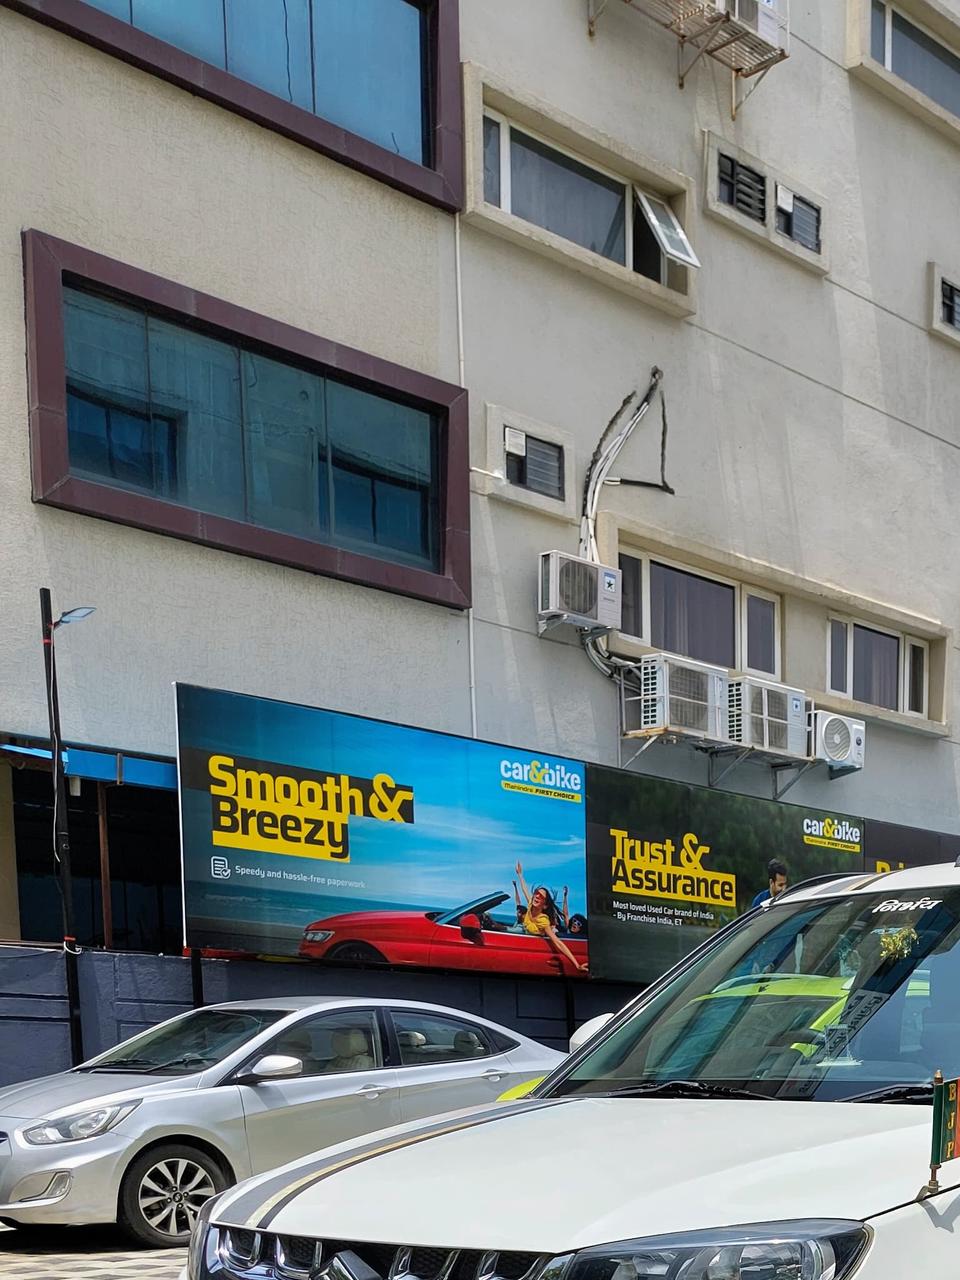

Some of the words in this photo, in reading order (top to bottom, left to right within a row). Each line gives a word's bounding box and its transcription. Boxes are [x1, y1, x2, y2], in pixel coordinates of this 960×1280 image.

[208, 755, 364, 817] Smooth
[369, 773, 414, 823] &
[500, 760, 581, 791] car&bike
[535, 788, 553, 796] FIRST
[553, 791, 576, 800] CHOICE
[212, 795, 349, 859] Breezy
[803, 817, 860, 842] car&bike
[610, 828, 675, 866] Trust
[680, 832, 710, 871] &
[235, 865, 265, 878] Speedy
[267, 868, 282, 879] and
[283, 871, 326, 884] hassle-free
[327, 876, 366, 889] paperwork
[612, 858, 733, 901] Assurance
[613, 901, 629, 910] Most
[629, 902, 647, 912] loved
[647, 904, 663, 914] Used
[663, 906, 674, 915] Car
[674, 907, 692, 917] brand
[693, 909, 700, 918] of
[700, 911, 714, 920] India
[617, 911, 626, 921] By
[627, 913, 656, 924] Franchise
[674, 918, 683, 926] ET
